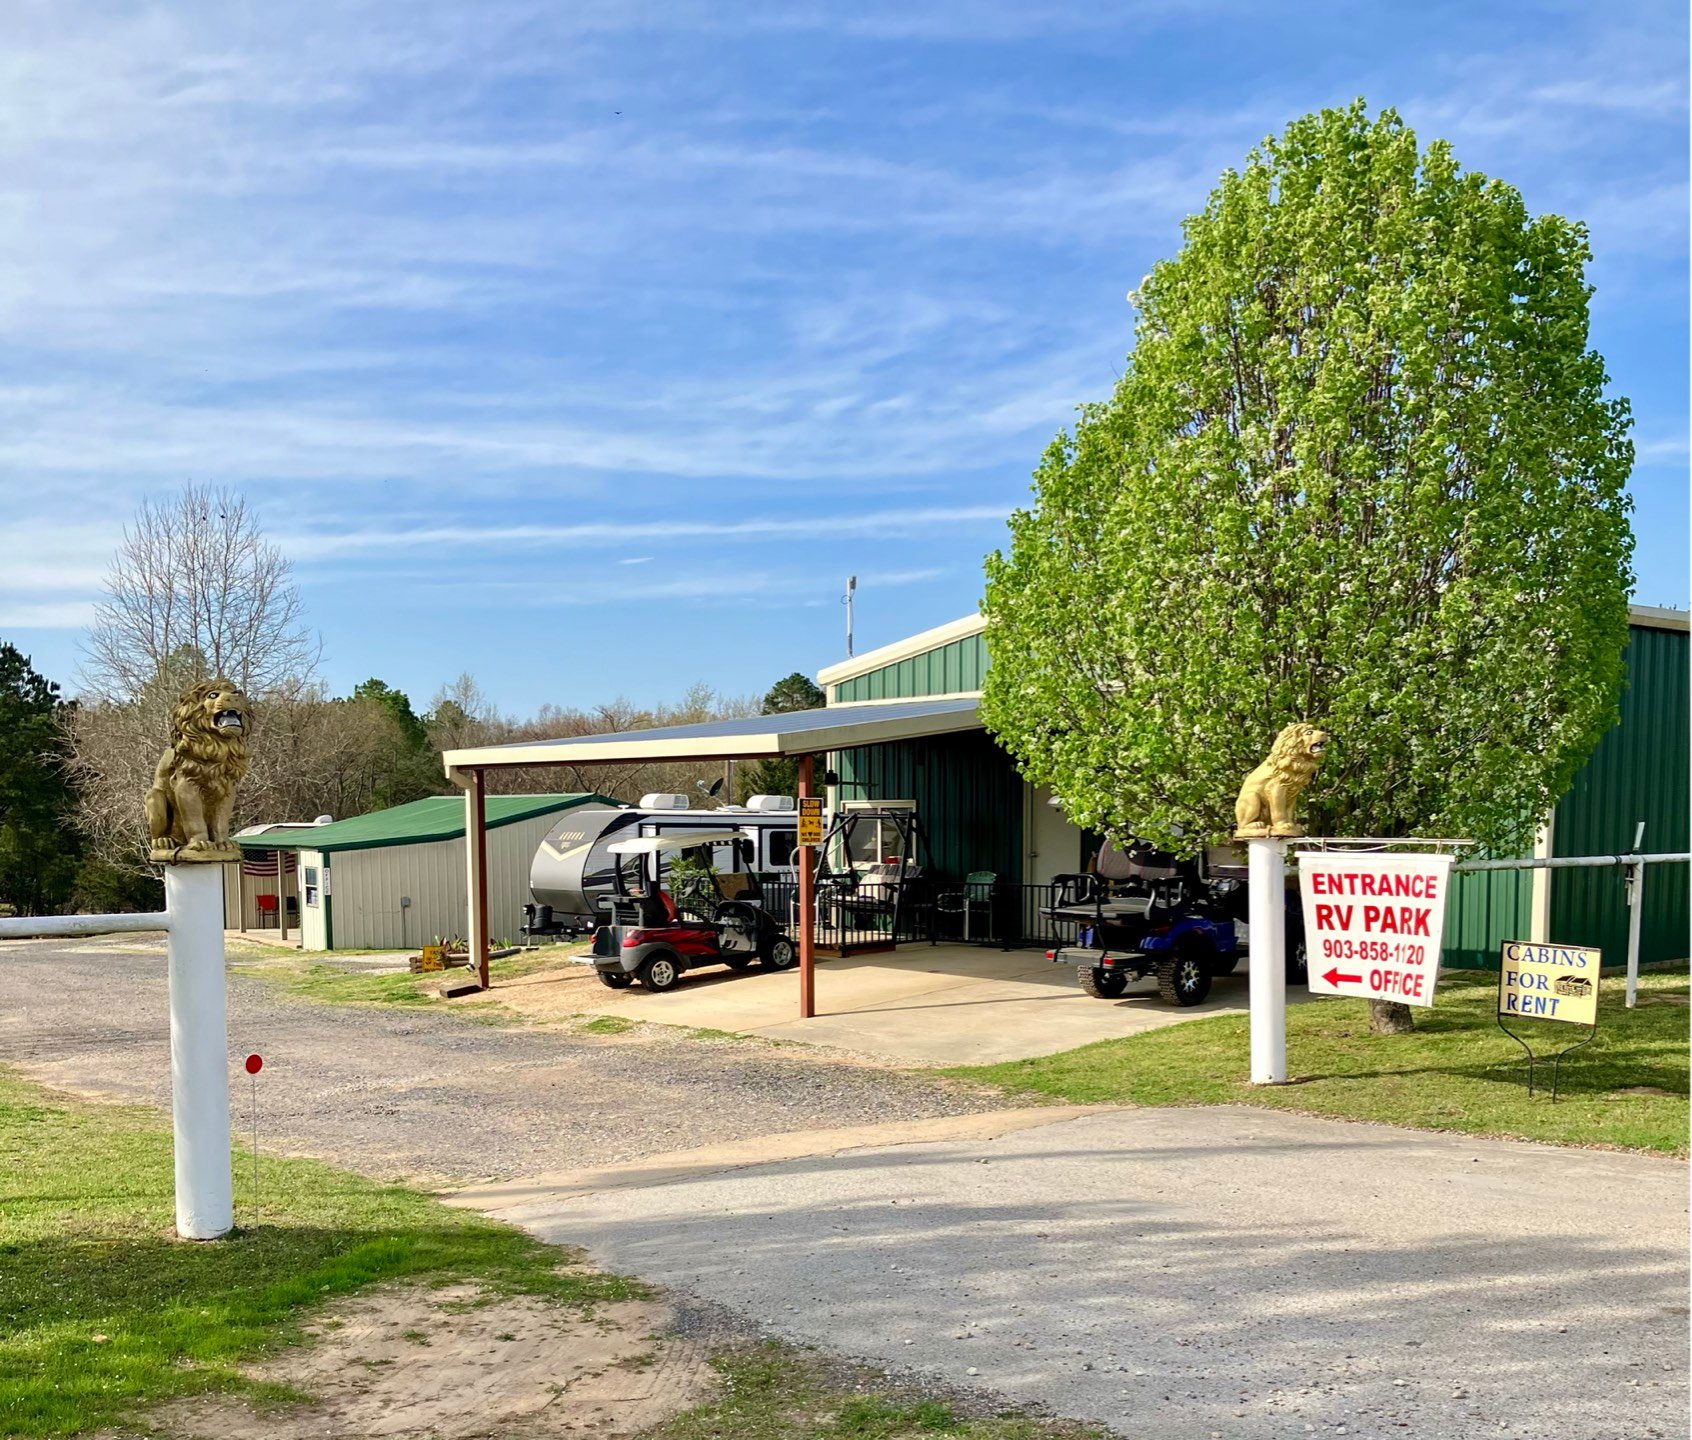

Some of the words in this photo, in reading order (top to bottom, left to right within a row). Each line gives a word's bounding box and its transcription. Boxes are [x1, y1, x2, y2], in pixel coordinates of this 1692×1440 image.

[1312, 873, 1438, 899] ENTRANCE
[1315, 904, 1354, 932] RV
[1363, 905, 1432, 937] PARK
[1323, 939, 1424, 965] 903-858-1120
[1506, 944, 1588, 969] CABINS
[1370, 969, 1424, 997] OFFICE
[1505, 970, 1551, 991] FOR
[1505, 992, 1561, 1017] RENT
